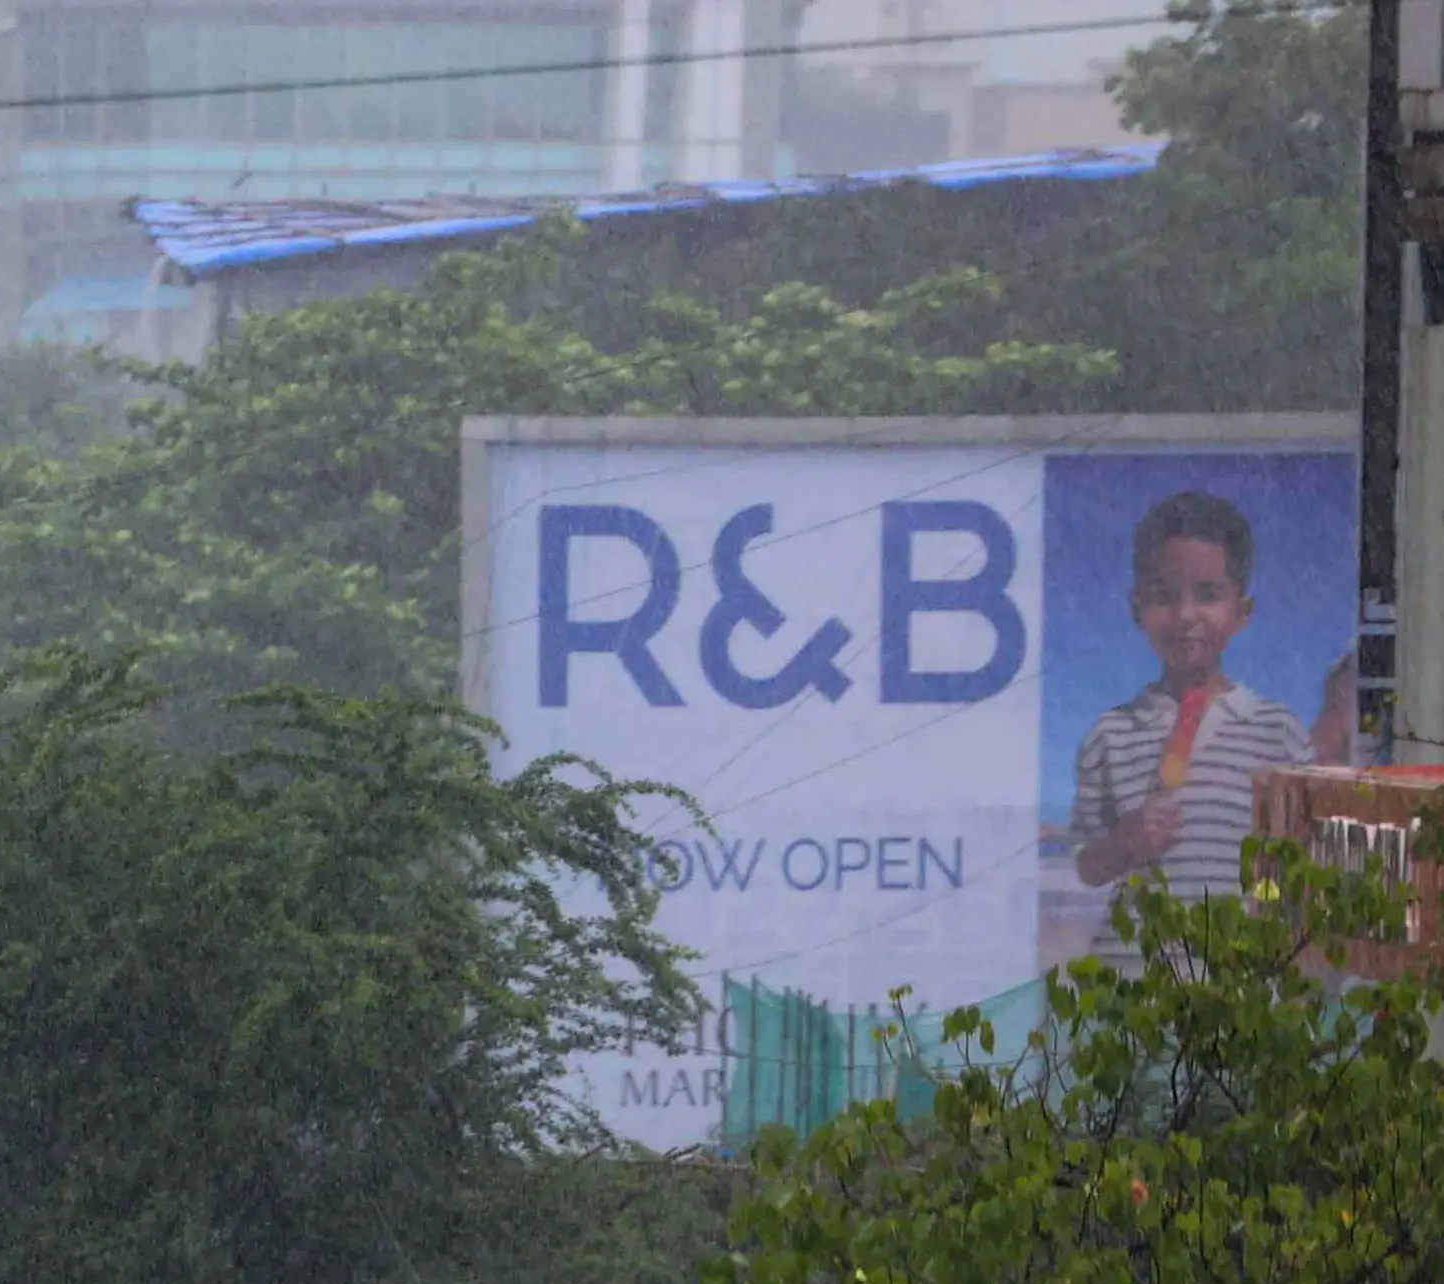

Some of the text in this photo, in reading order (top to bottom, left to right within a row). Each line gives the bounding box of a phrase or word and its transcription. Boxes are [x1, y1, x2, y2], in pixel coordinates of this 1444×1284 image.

[536, 498, 1028, 711] R&B
[596, 836, 964, 893] OW OPEN
